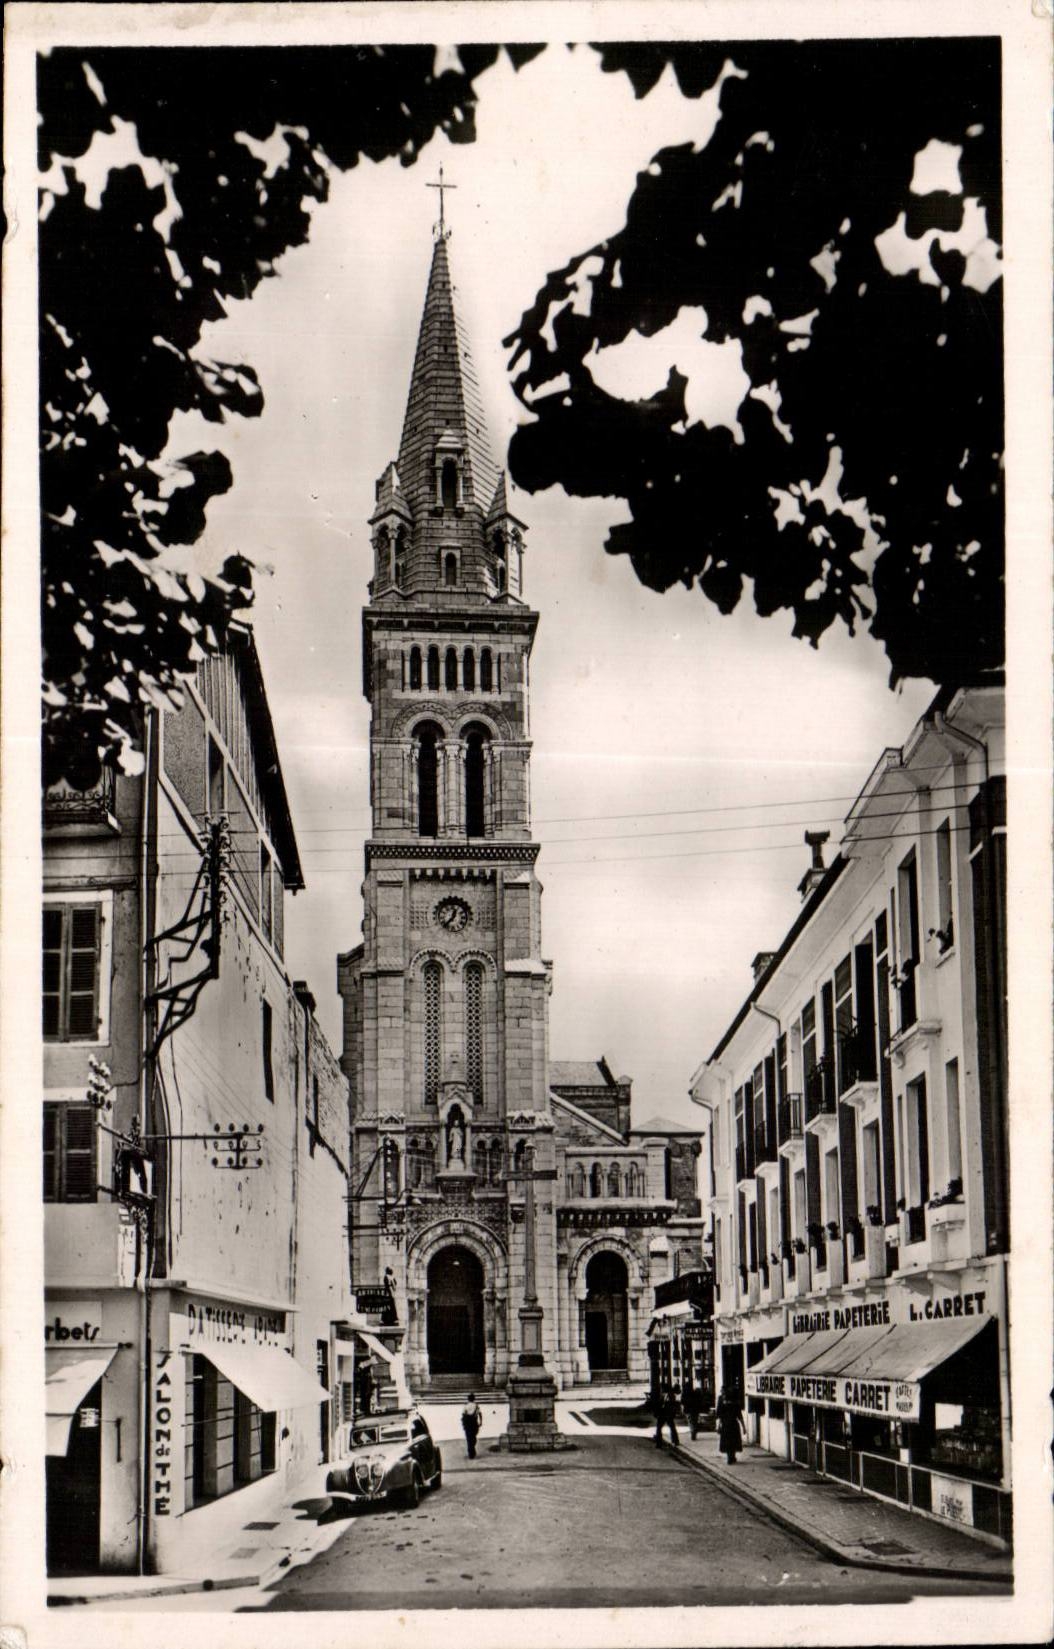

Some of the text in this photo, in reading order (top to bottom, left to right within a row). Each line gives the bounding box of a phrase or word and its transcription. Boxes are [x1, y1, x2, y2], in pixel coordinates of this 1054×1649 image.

[910, 1304, 923, 1321] L.
[925, 1292, 986, 1320] CARRET
[156, 1354, 171, 1442] SALON
[756, 1376, 786, 1395] LIBRAIRIE
[790, 1377, 837, 1402] PAPETERIE
[845, 1382, 891, 1411] CARRET
